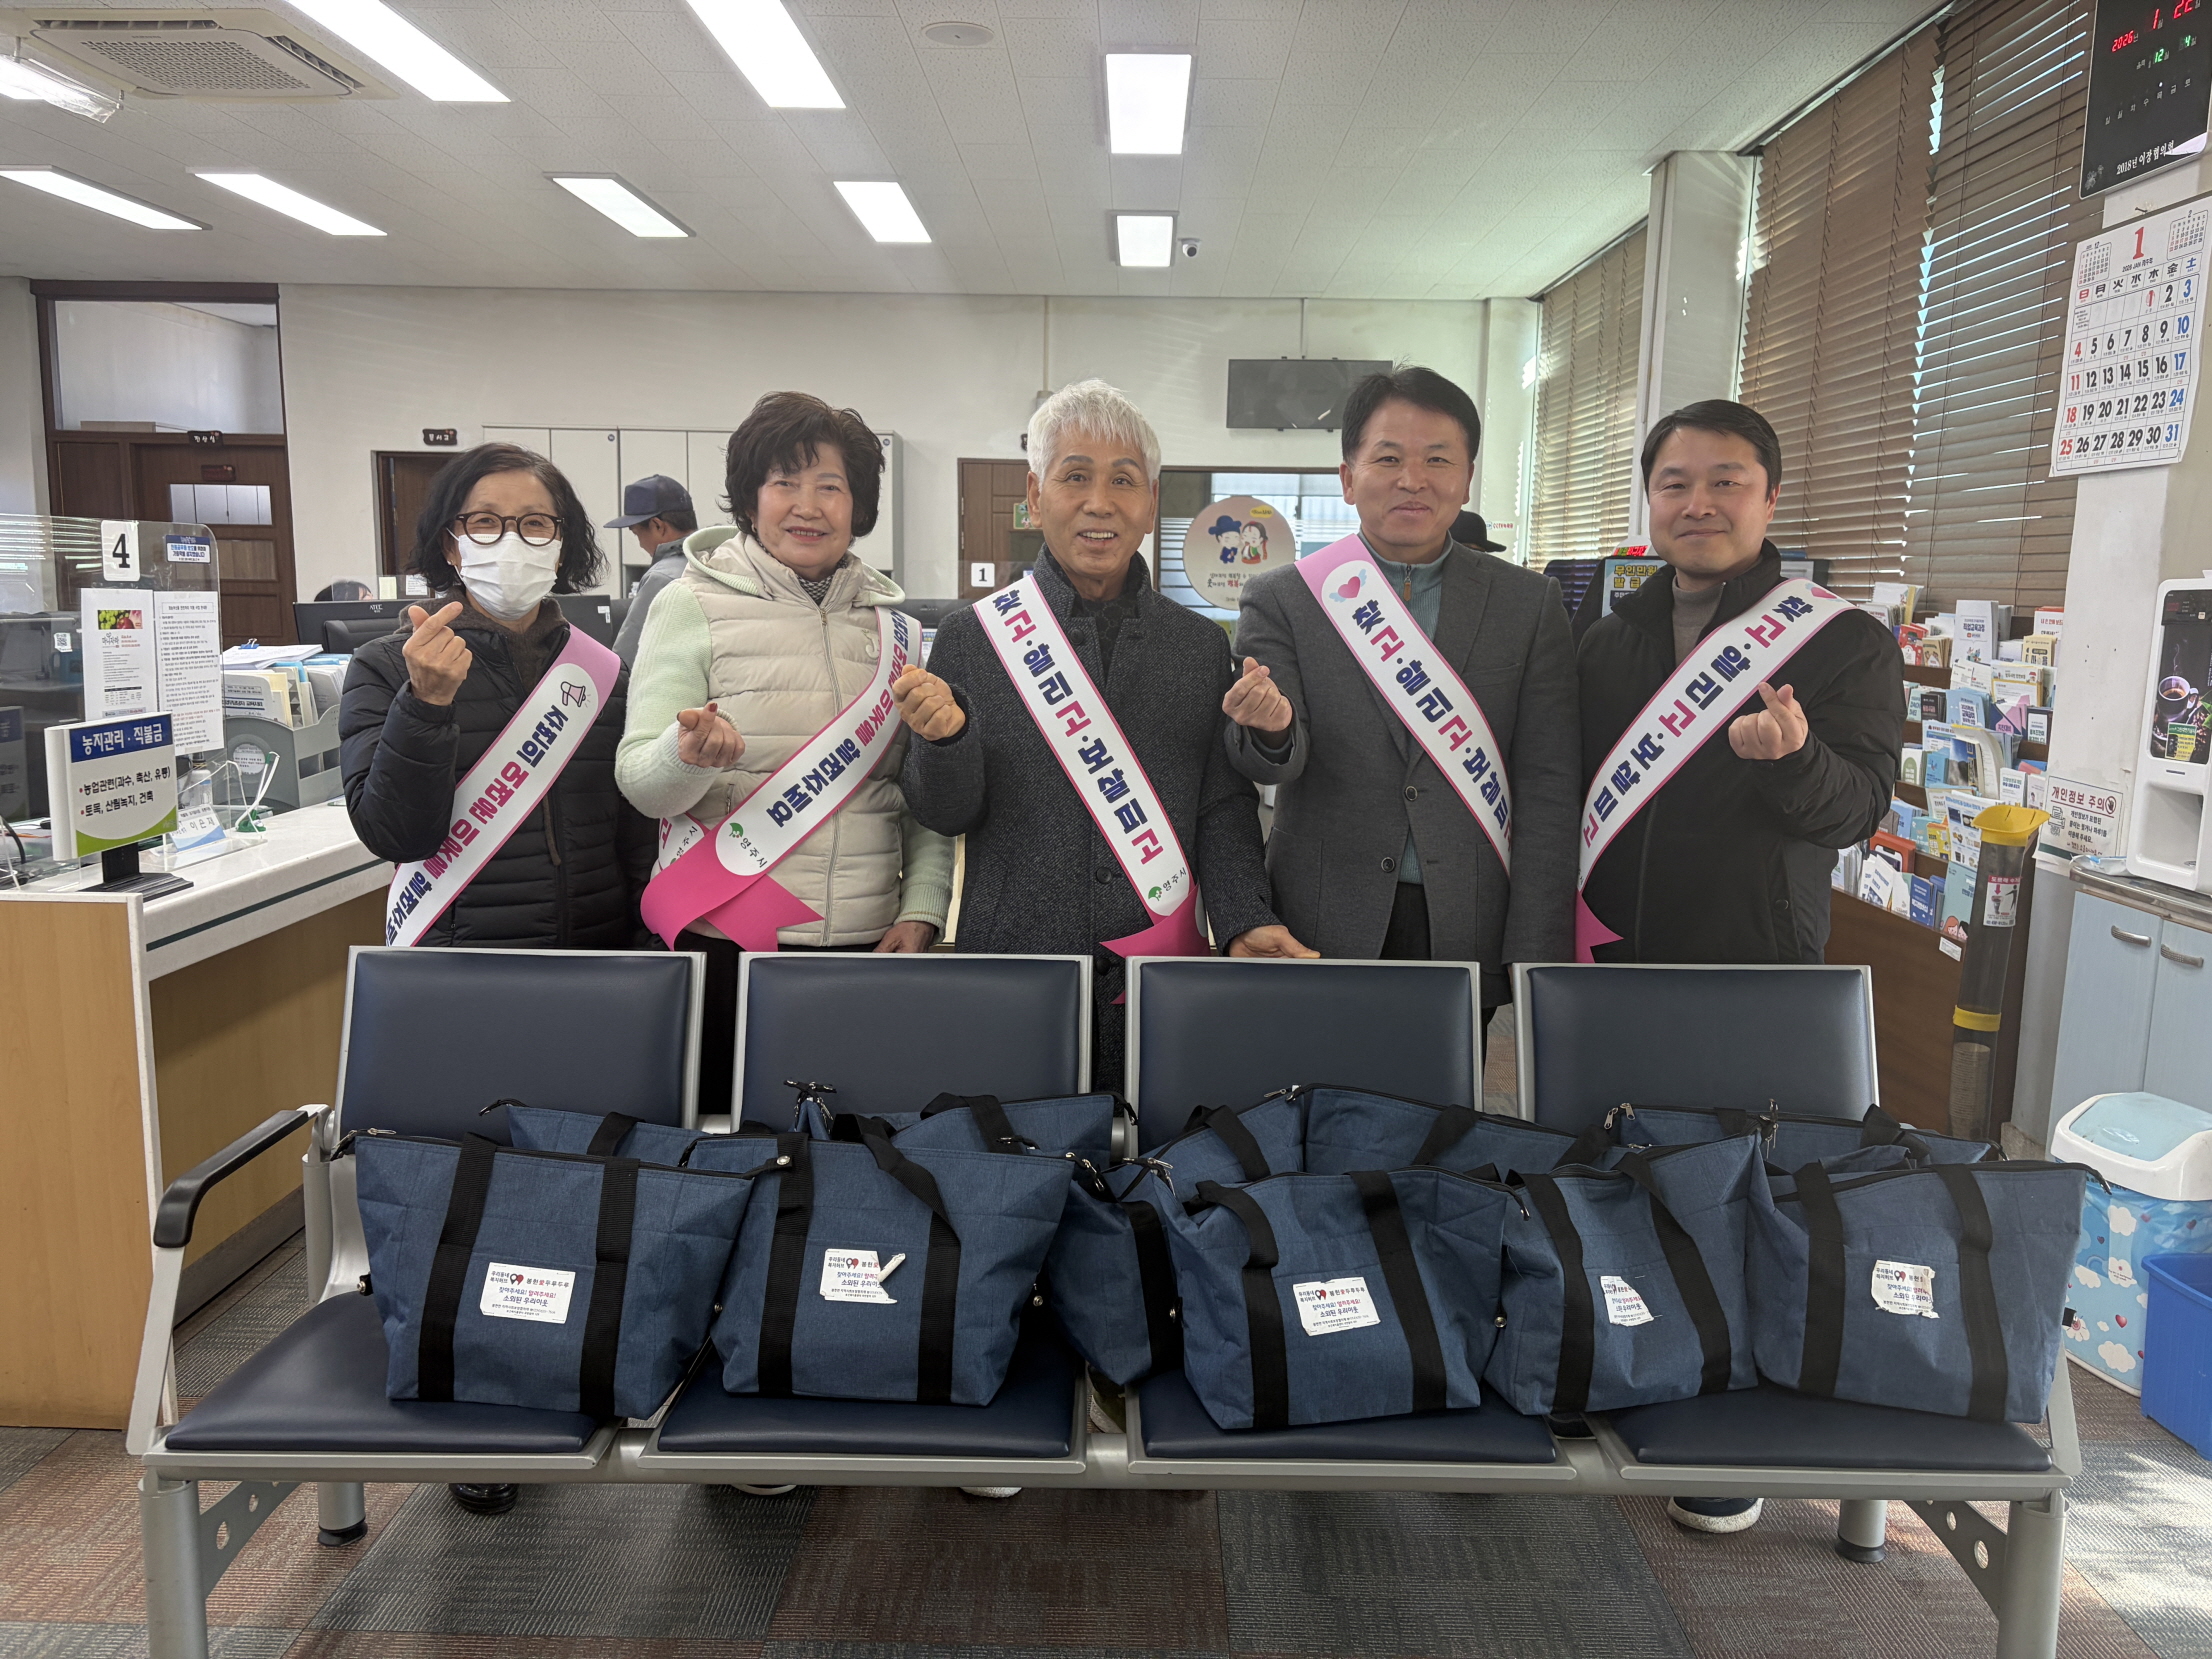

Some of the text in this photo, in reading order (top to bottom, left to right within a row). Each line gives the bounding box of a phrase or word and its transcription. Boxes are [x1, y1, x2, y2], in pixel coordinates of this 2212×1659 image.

[2116, 157, 2137, 175] 2018년
[2133, 226, 2145, 260] 1
[2079, 257, 2197, 299] 日 月 火 水 木 金 土
[2164, 284, 2173, 303] 2
[2183, 279, 2192, 298] 3
[2074, 315, 2190, 357] 4 5 6 7 8 9 10
[2071, 351, 2187, 391] 11 12 13 14 15 16 17
[2066, 388, 2185, 424] 18 19 20 21 22 23 24
[2059, 423, 2179, 456] 25 26 27 28 29 30 31
[112, 533, 131, 569] 4
[978, 567, 988, 582] 1
[1614, 564, 1658, 577] 무인민원
[855, 688, 894, 747] 이웃을
[82, 723, 163, 755] 농지관리 직불금
[83, 774, 135, 796] 농업관련(과수,
[766, 738, 862, 828] 알려주세요
[2052, 786, 2106, 811] 개인정보 주의
[85, 791, 154, 818] 토목, 산림녹지, 건축
[386, 705, 569, 947] 주변의 어려운 이웃을 알려주세
[676, 825, 698, 858] 영주시
[740, 837, 768, 868] 영주시
[1162, 866, 1187, 892] 영주시
